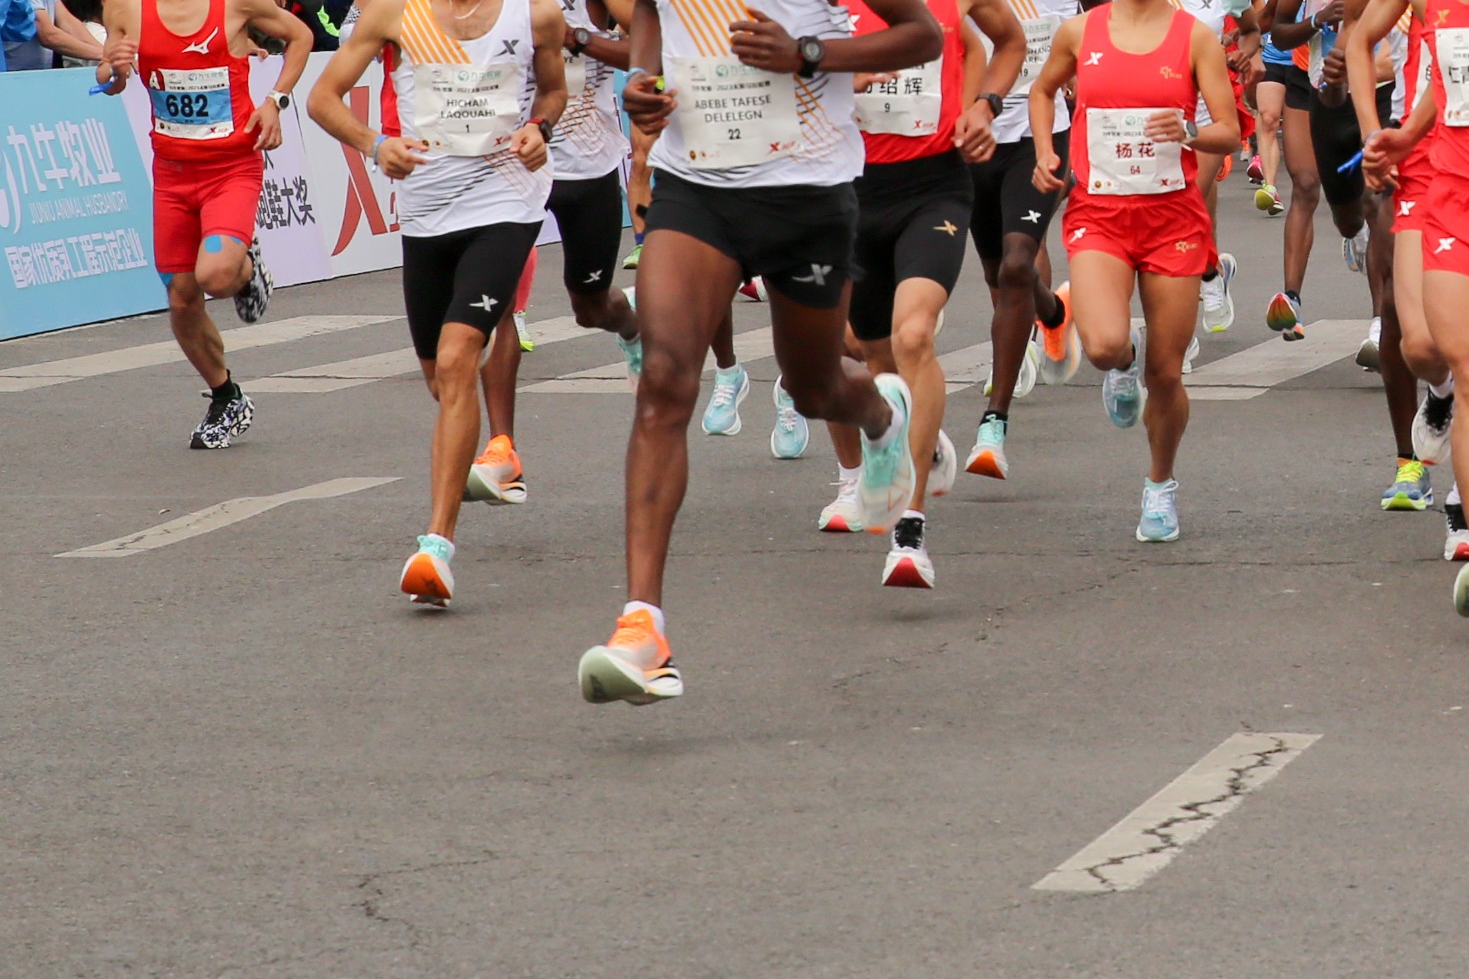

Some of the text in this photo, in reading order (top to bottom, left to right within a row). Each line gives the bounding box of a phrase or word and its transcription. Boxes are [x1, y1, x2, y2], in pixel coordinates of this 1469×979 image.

[166, 93, 209, 117] 682
[446, 98, 488, 108] HICHAM
[694, 94, 772, 110] ABEBE TAFESE
[884, 102, 891, 113] 9
[440, 109, 496, 119] LAQOUAHI
[704, 110, 763, 123] DELELEGN
[466, 124, 470, 133] 1
[728, 128, 741, 140] 22
[1116, 141, 1155, 158] 杨花
[6, 118, 122, 195] 九牛牧业
[1130, 165, 1141, 174] 64
